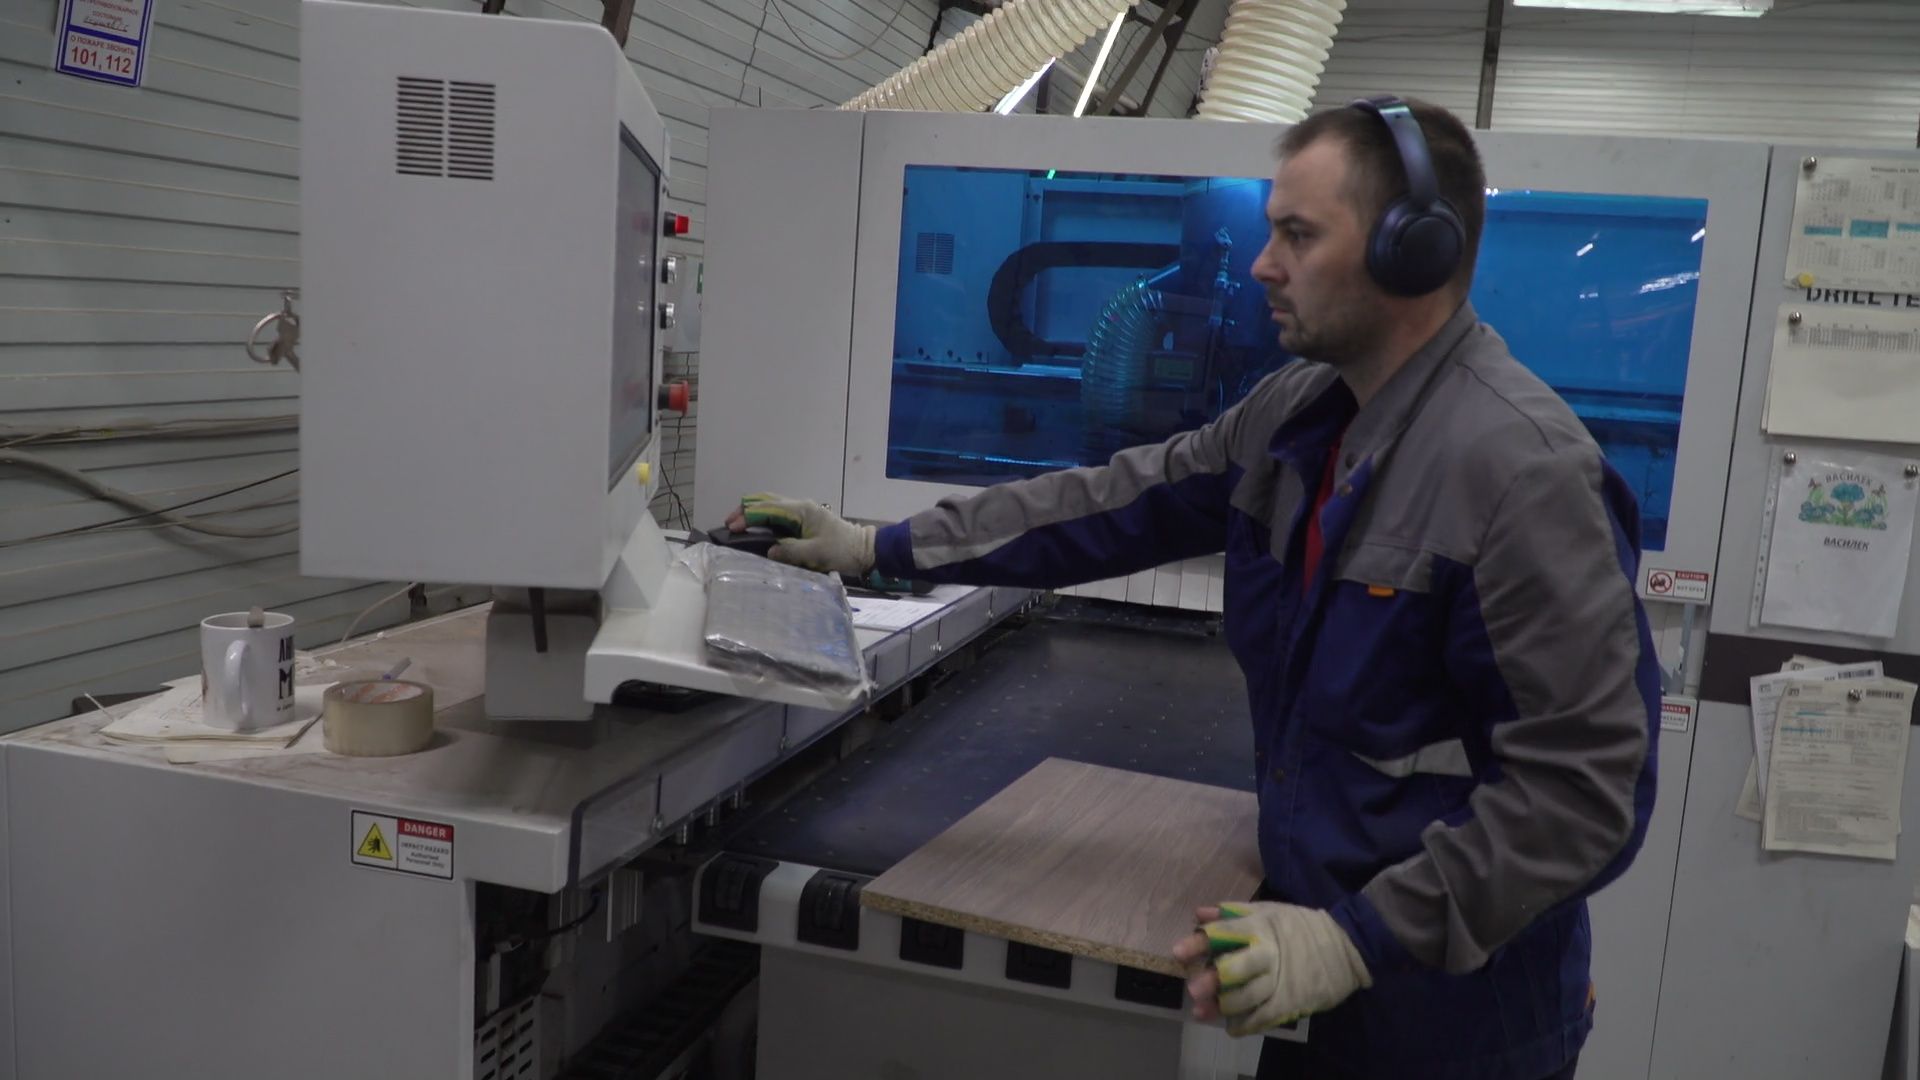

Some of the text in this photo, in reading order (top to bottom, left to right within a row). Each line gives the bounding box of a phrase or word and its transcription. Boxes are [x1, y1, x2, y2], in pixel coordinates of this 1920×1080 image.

[77, 37, 105, 49] ПОЖАРЕ
[1824, 535, 1870, 552] ВАСИЛЕК
[1677, 572, 1705, 580] CAUTION
[404, 822, 446, 838] DANGER
[401, 841, 449, 855] IMPACT HAZARD
